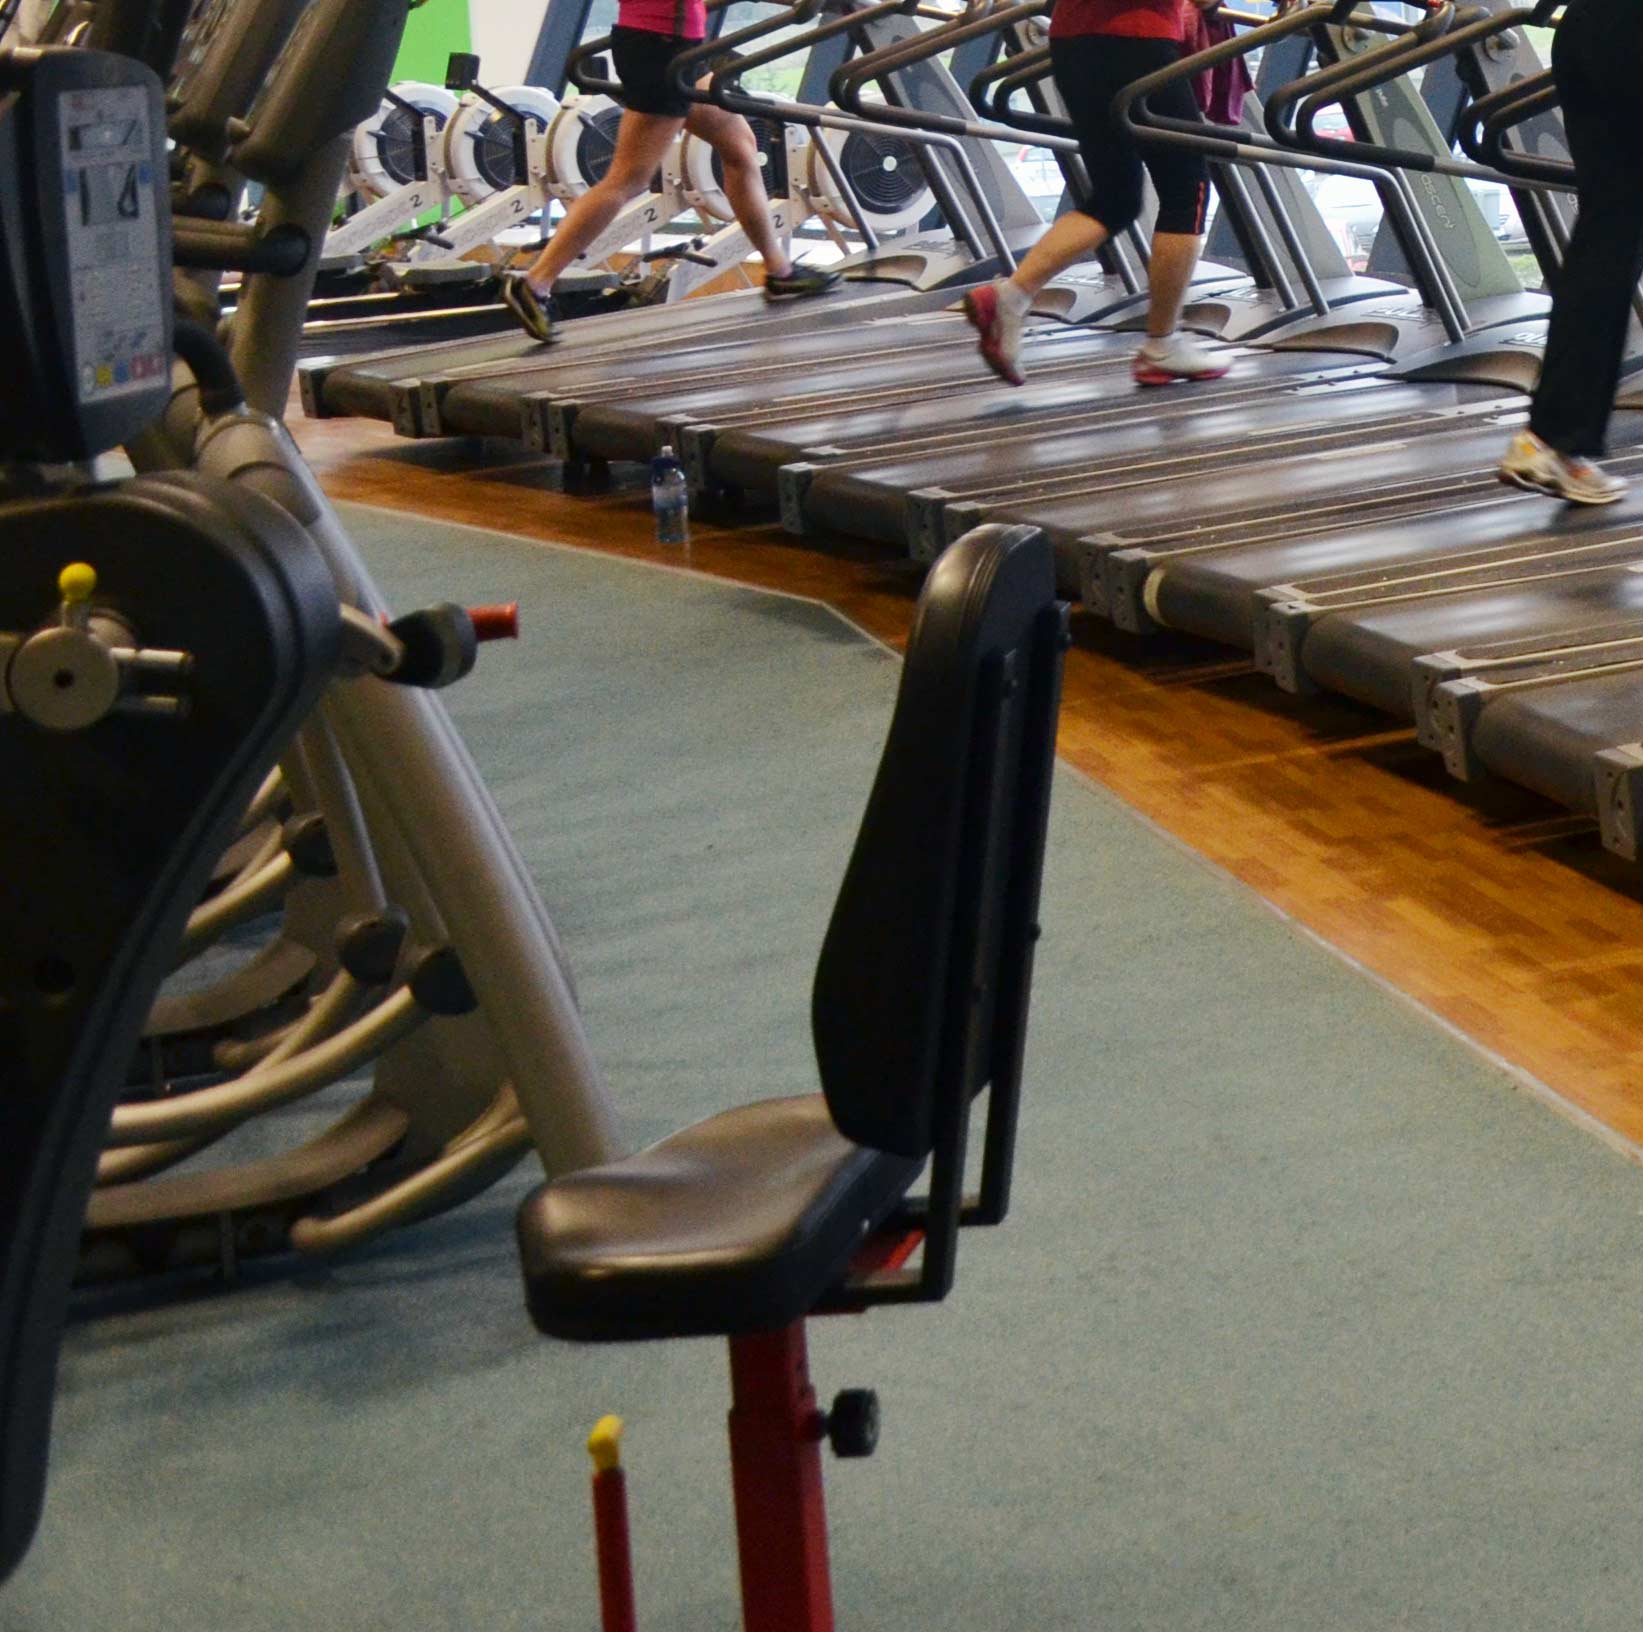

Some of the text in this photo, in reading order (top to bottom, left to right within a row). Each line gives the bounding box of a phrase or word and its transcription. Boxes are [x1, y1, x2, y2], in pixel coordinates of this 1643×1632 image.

[410, 194, 424, 208] 2
[511, 199, 525, 214] 2
[644, 207, 658, 222] 2
[773, 214, 785, 229] 2
